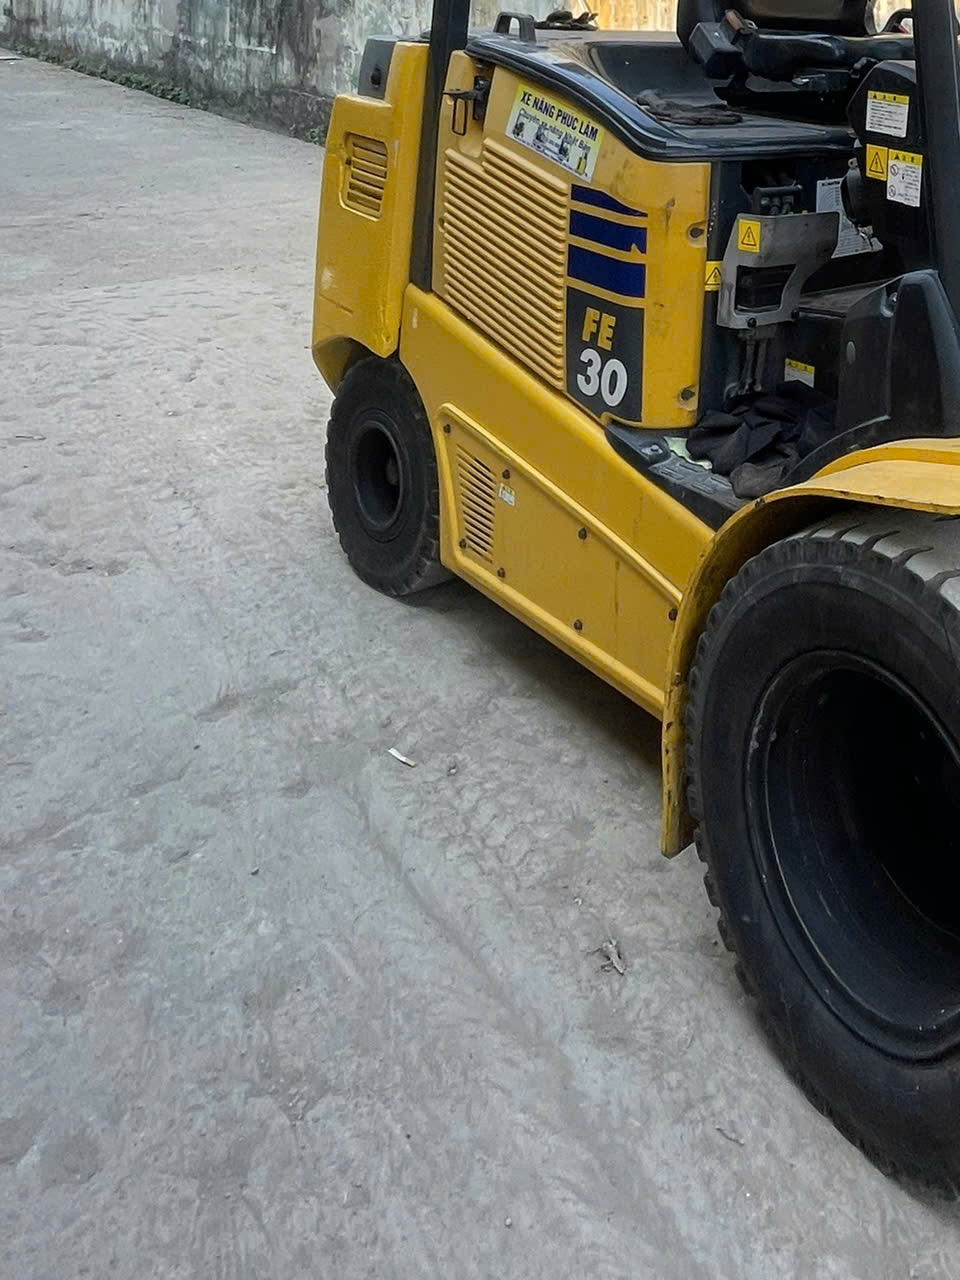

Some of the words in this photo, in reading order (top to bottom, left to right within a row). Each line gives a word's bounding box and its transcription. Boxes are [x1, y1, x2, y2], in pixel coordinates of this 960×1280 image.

[520, 91, 533, 106] XE
[582, 306, 616, 351] FE
[576, 348, 628, 407] 30
